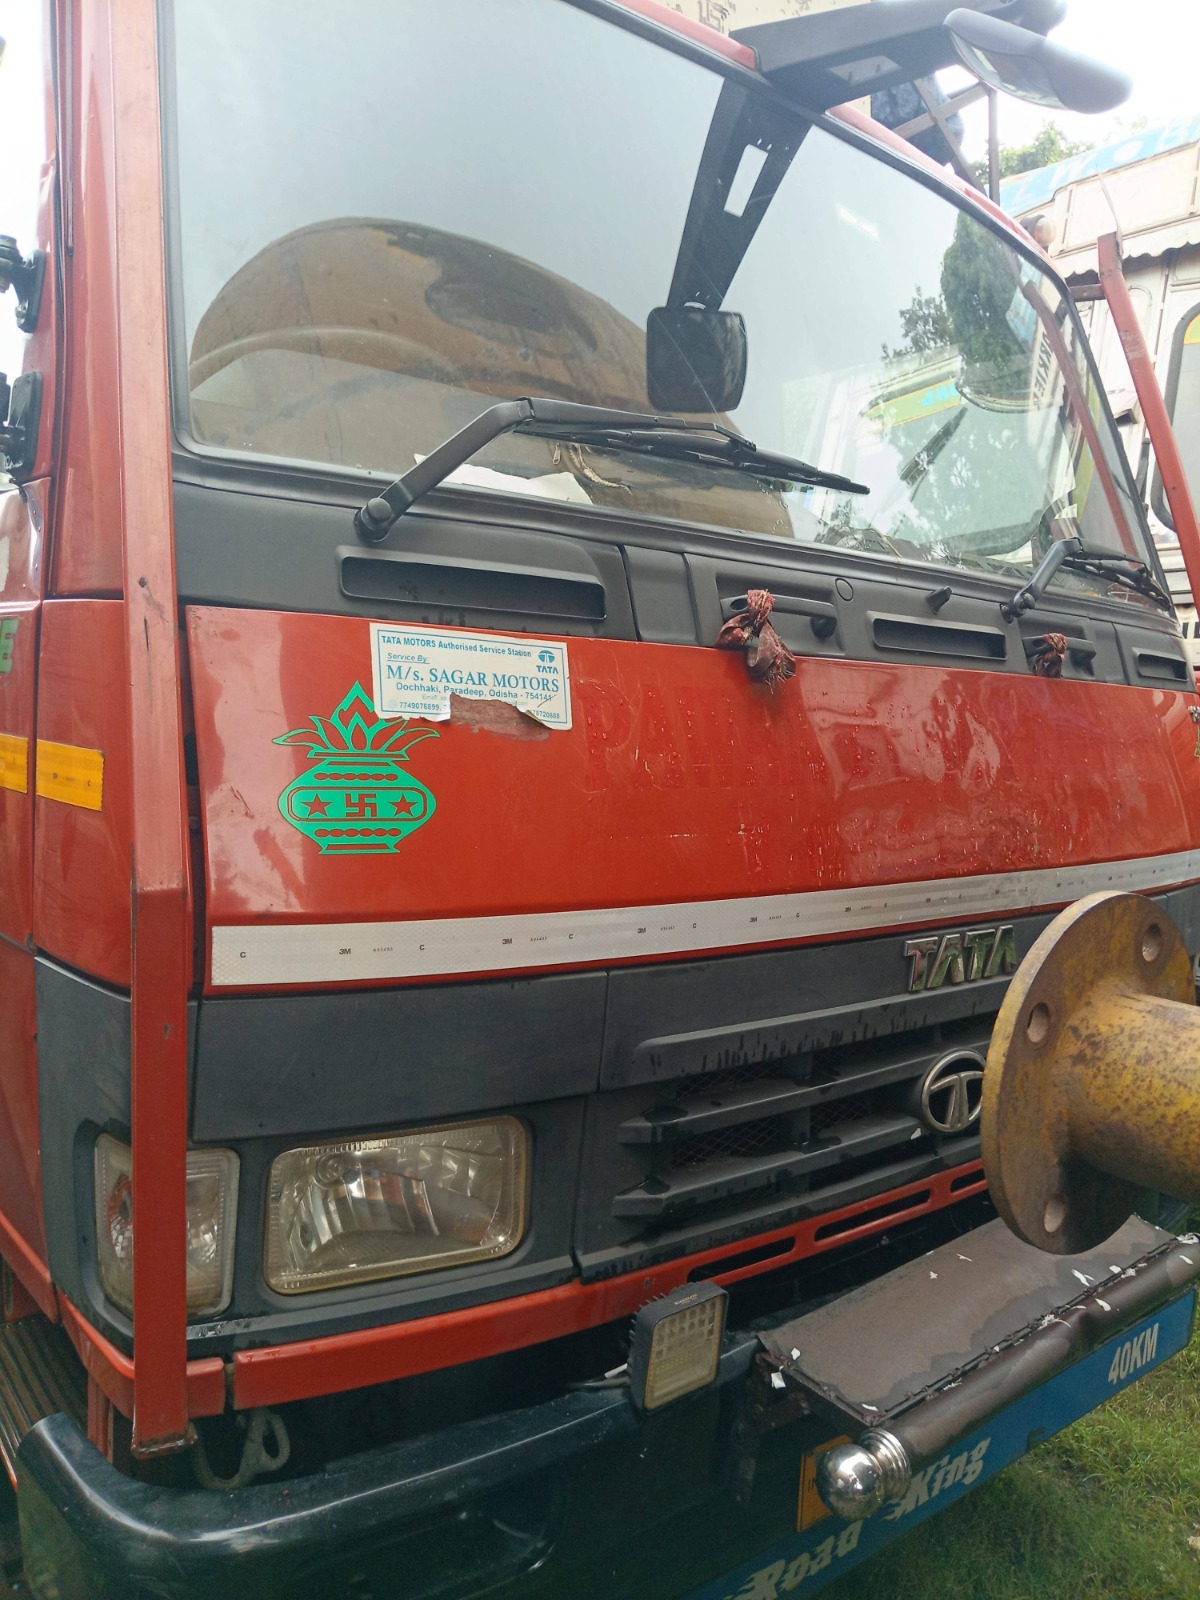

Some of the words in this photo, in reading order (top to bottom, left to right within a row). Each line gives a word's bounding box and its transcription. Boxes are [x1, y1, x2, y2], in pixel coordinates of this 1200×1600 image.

[381, 635, 402, 645] TATA
[404, 637, 436, 648] MOTORS
[438, 641, 478, 652] Authorised
[479, 644, 506, 655] Service
[507, 647, 532, 658] Station
[387, 652, 416, 661] Service
[386, 665, 424, 681] M/s.
[429, 668, 488, 685] SAGAR
[492, 673, 559, 693] MOTORS
[536, 665, 559, 675] TATA
[396, 682, 441, 693] Dochhaki,
[488, 689, 518, 699] Odisha
[904, 924, 1017, 992] TATA
[1108, 1322, 1159, 1385] 40KM
[723, 1520, 864, 1600] Road
[881, 1437, 991, 1521] King
